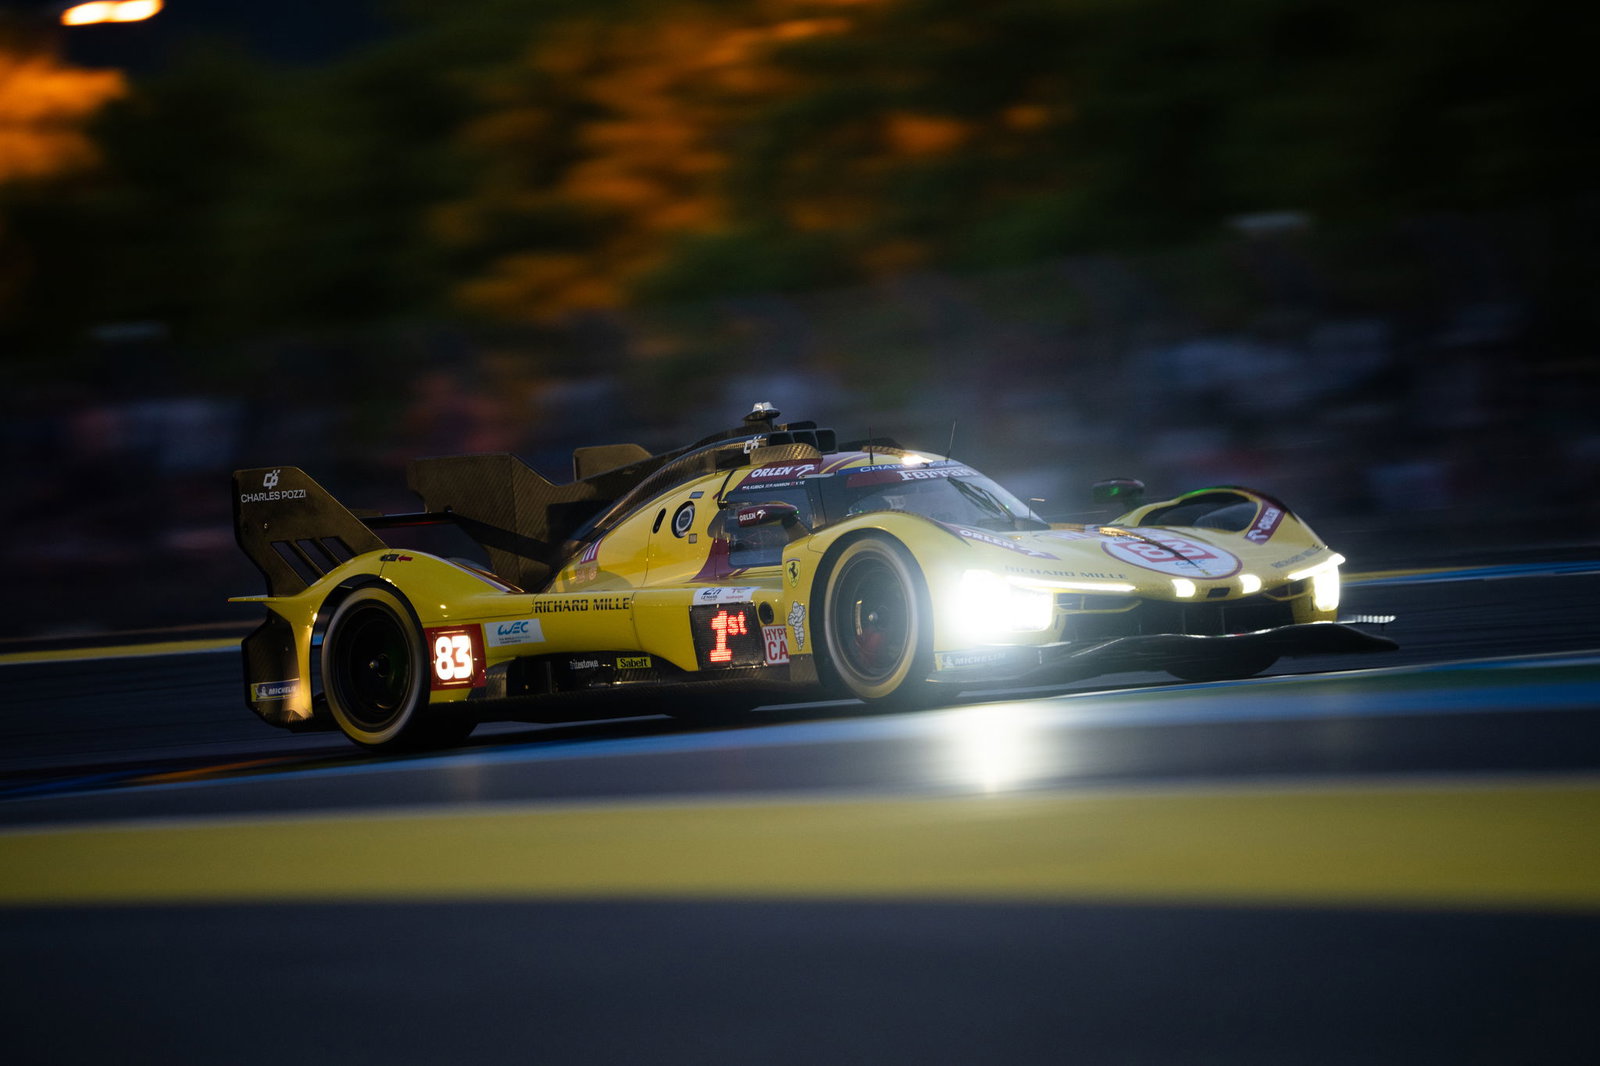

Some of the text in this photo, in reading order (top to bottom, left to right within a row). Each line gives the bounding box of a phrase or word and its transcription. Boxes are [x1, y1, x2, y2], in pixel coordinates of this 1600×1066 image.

[751, 466, 791, 478] ORLEN
[897, 467, 978, 481] Ferrari
[240, 489, 307, 503] CHARLES POZZI
[739, 512, 756, 522] ORLEN
[959, 529, 1015, 550] ORLEN
[1079, 571, 1129, 581] MILLE
[534, 597, 630, 614] RICHARD MILLE
[497, 621, 529, 636] WEC
[709, 610, 748, 662] 1st
[435, 634, 473, 680] 83
[620, 658, 648, 668] Sabelt
[955, 652, 1006, 667] MICHELIN
